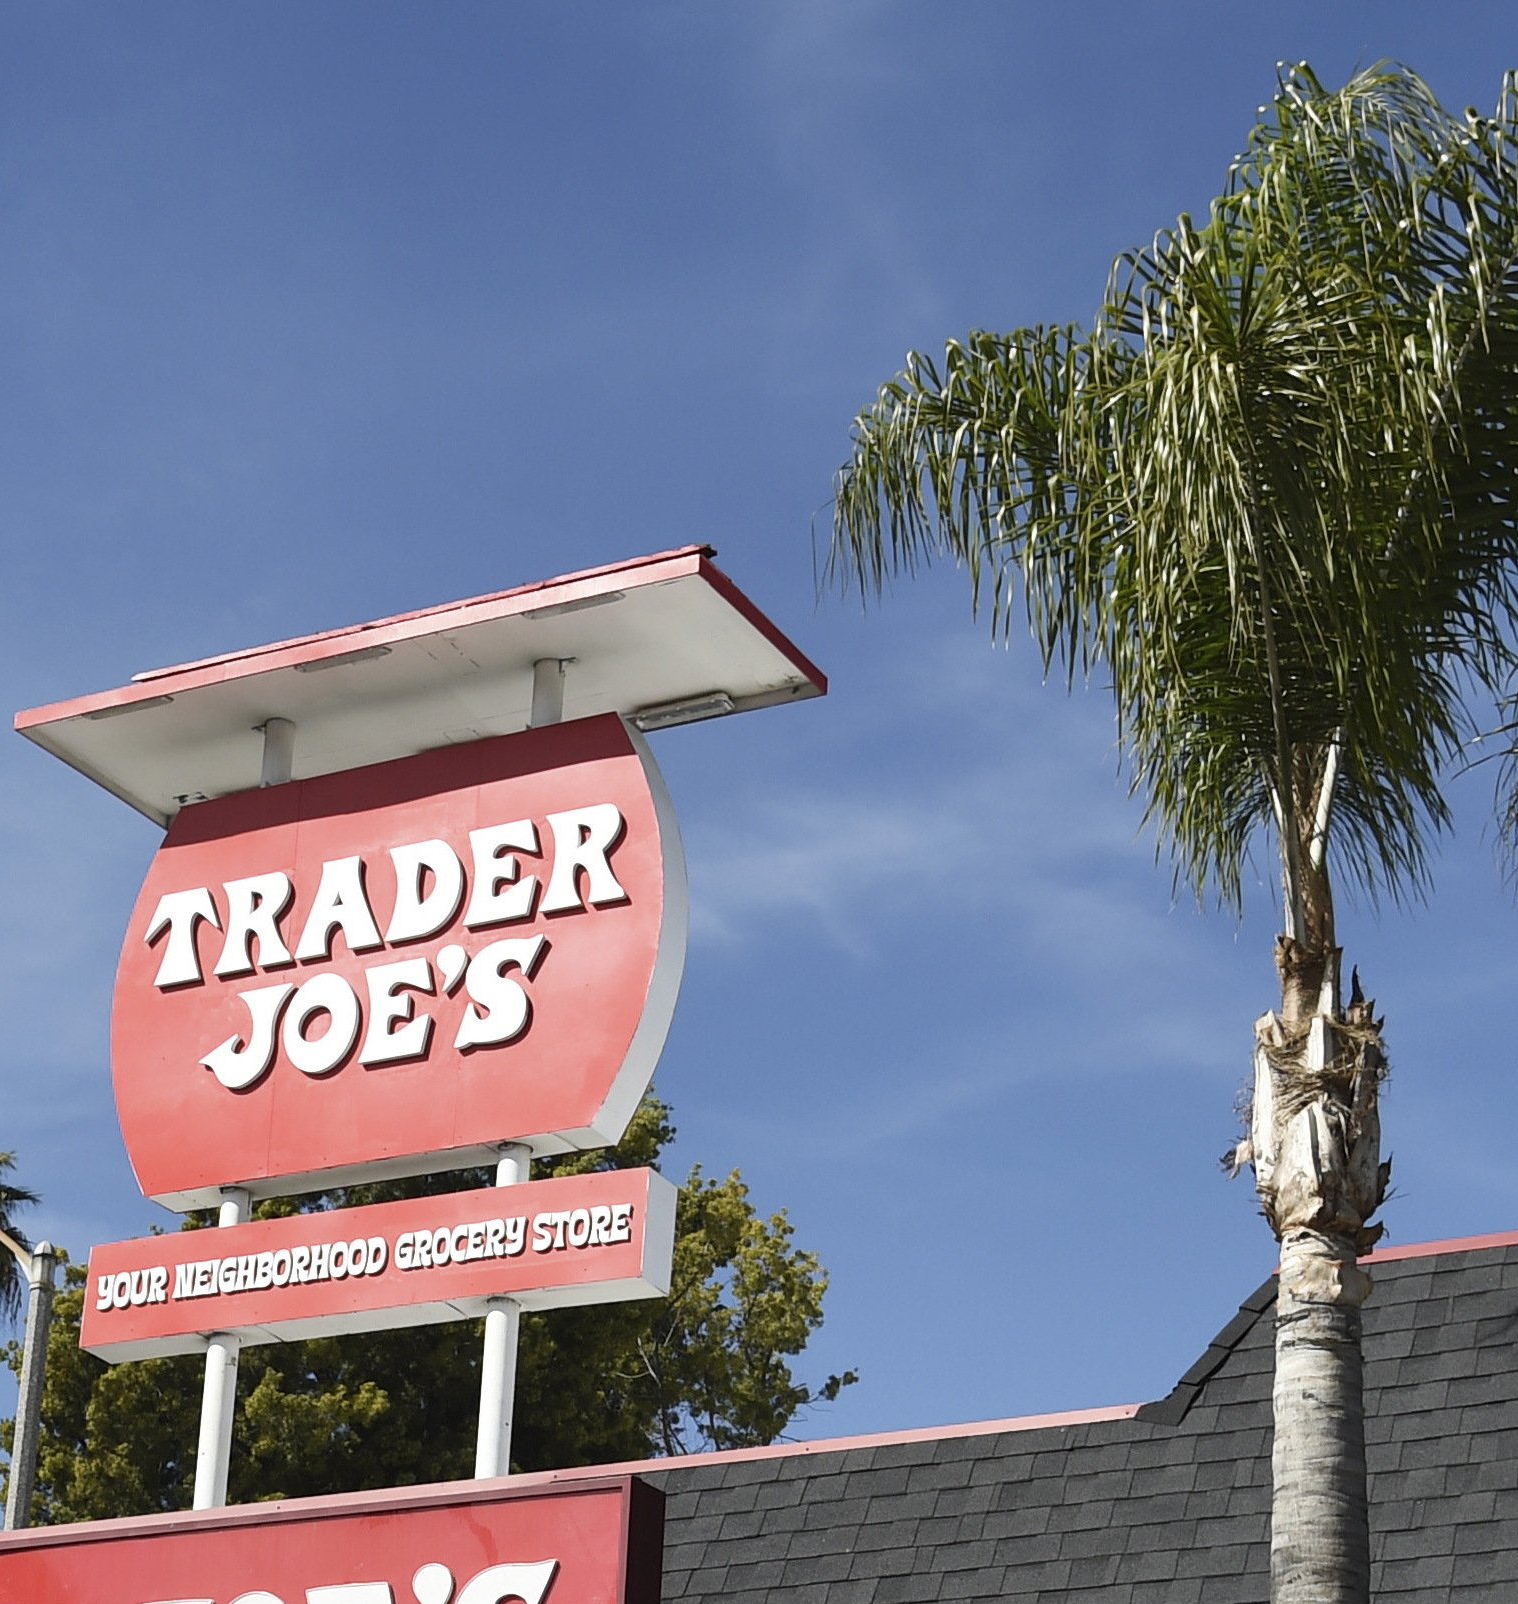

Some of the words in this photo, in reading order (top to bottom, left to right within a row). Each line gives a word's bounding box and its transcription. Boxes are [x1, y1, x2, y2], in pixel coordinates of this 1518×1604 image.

[143, 803, 627, 988] TRADER
[198, 933, 546, 1090] JOE'S
[96, 1263, 167, 1310] YOUR
[171, 1236, 388, 1299] NEIGHBORHOOD
[394, 1215, 527, 1270] GROCERY
[531, 1202, 633, 1252] STORE
